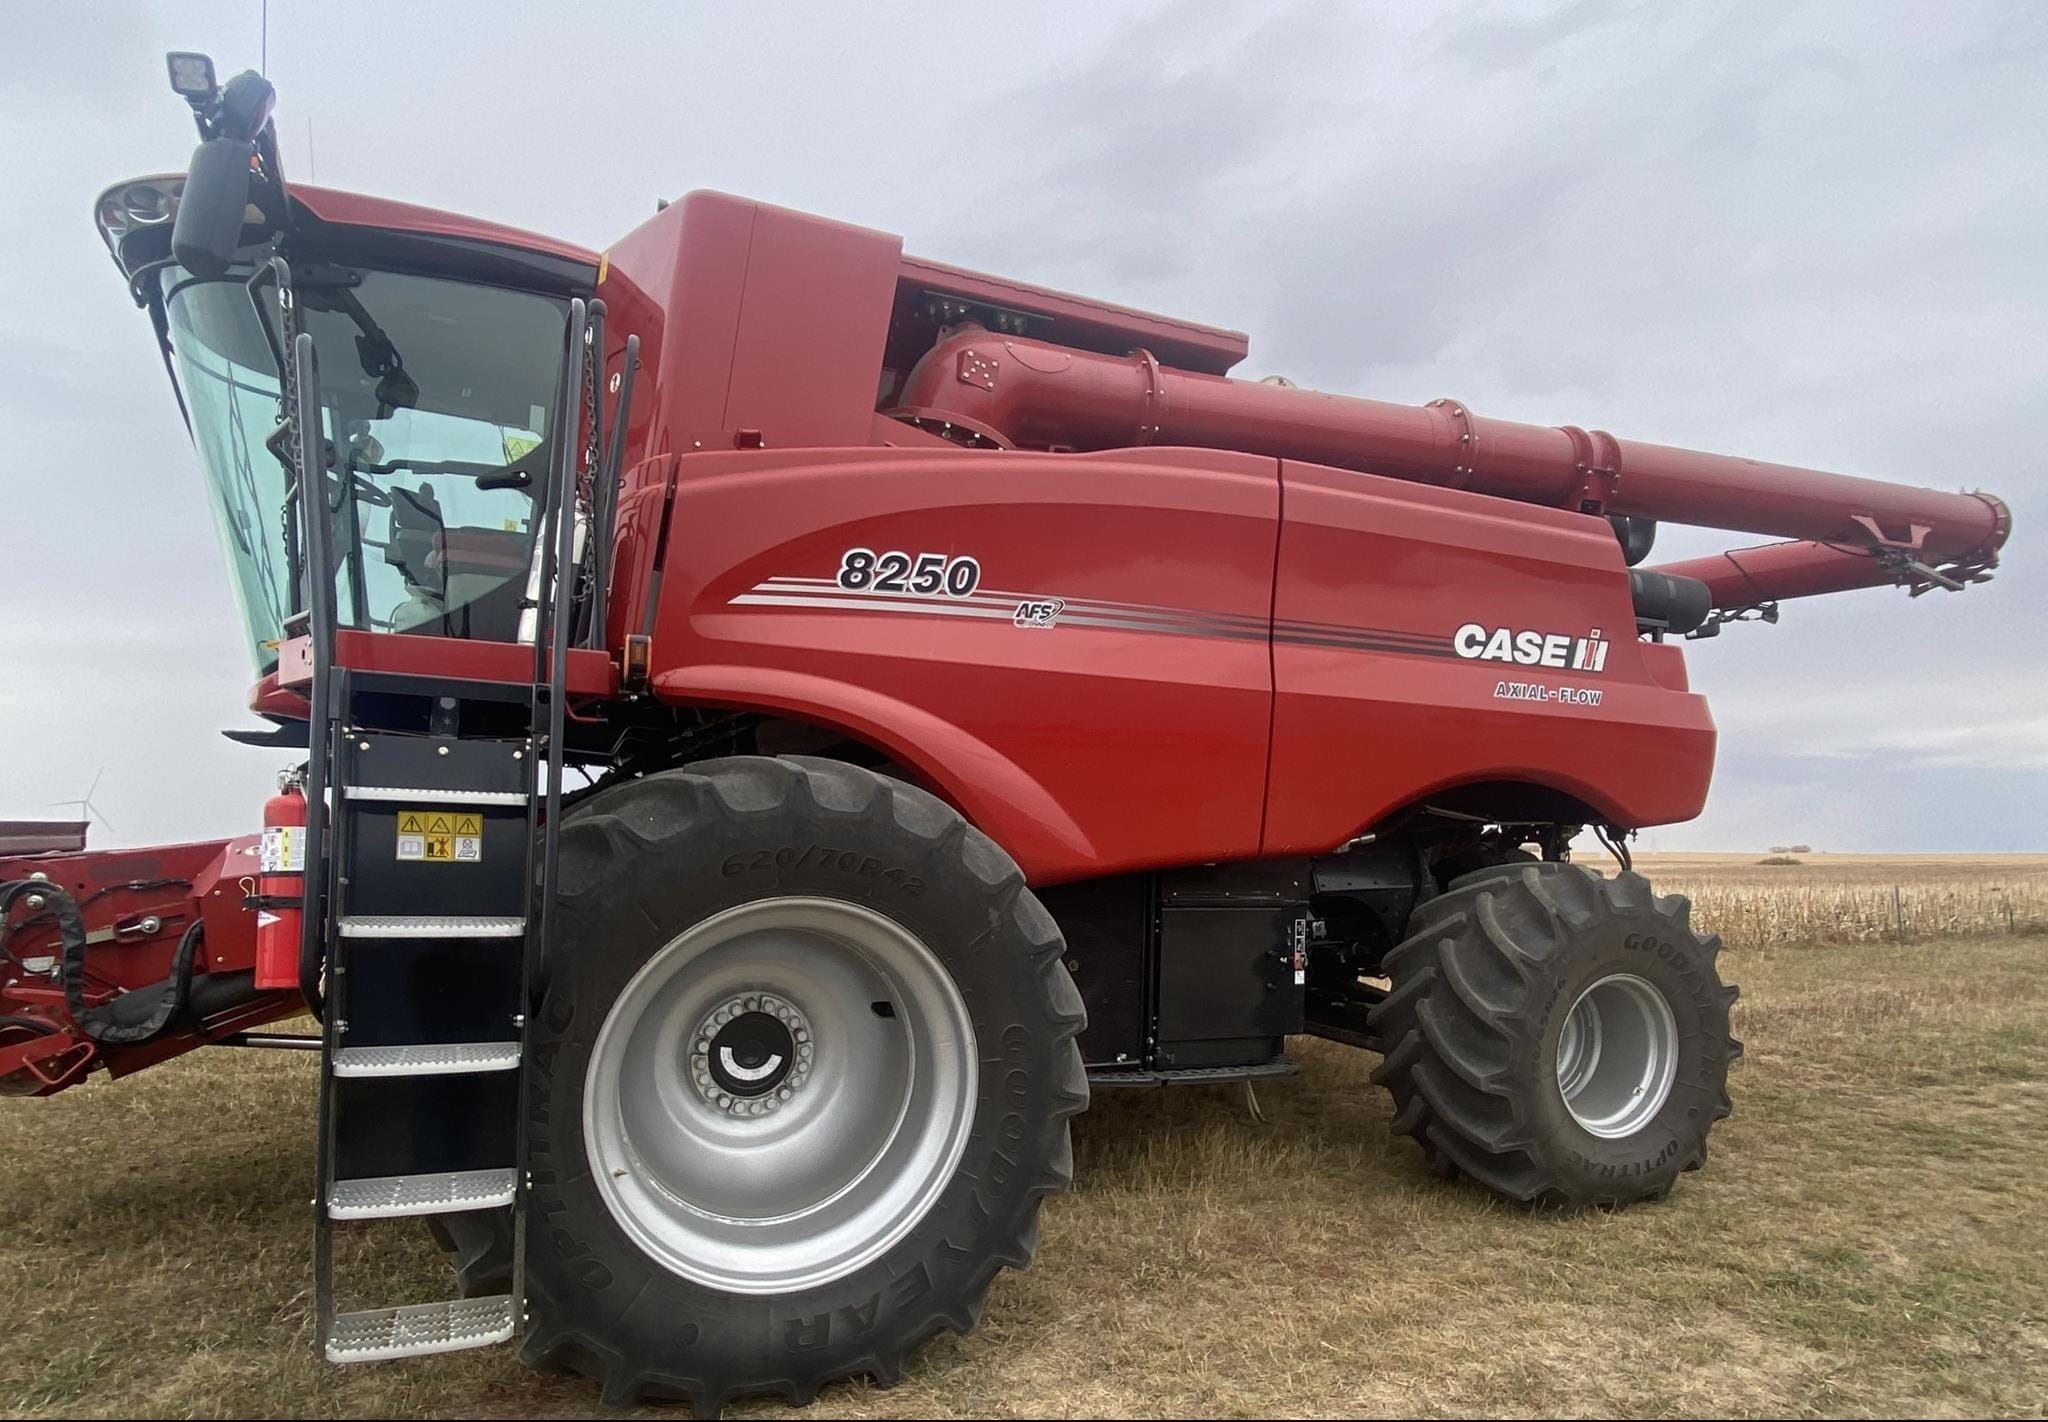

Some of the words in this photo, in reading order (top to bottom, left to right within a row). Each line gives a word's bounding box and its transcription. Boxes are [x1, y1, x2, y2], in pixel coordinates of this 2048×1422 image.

[837, 547, 981, 598] 8250
[1014, 601, 1054, 620] AFS
[1454, 623, 1571, 668] CASE
[1494, 681, 1603, 706] AXIAL-FLOW
[721, 843, 928, 897] 620/70R42
[1624, 932, 1718, 1080] GOODYEAR
[528, 995, 614, 1291] OPTITRAC
[1567, 1138, 1680, 1180] OPTITRAC
[784, 1024, 1031, 1354] GOODYEAR
